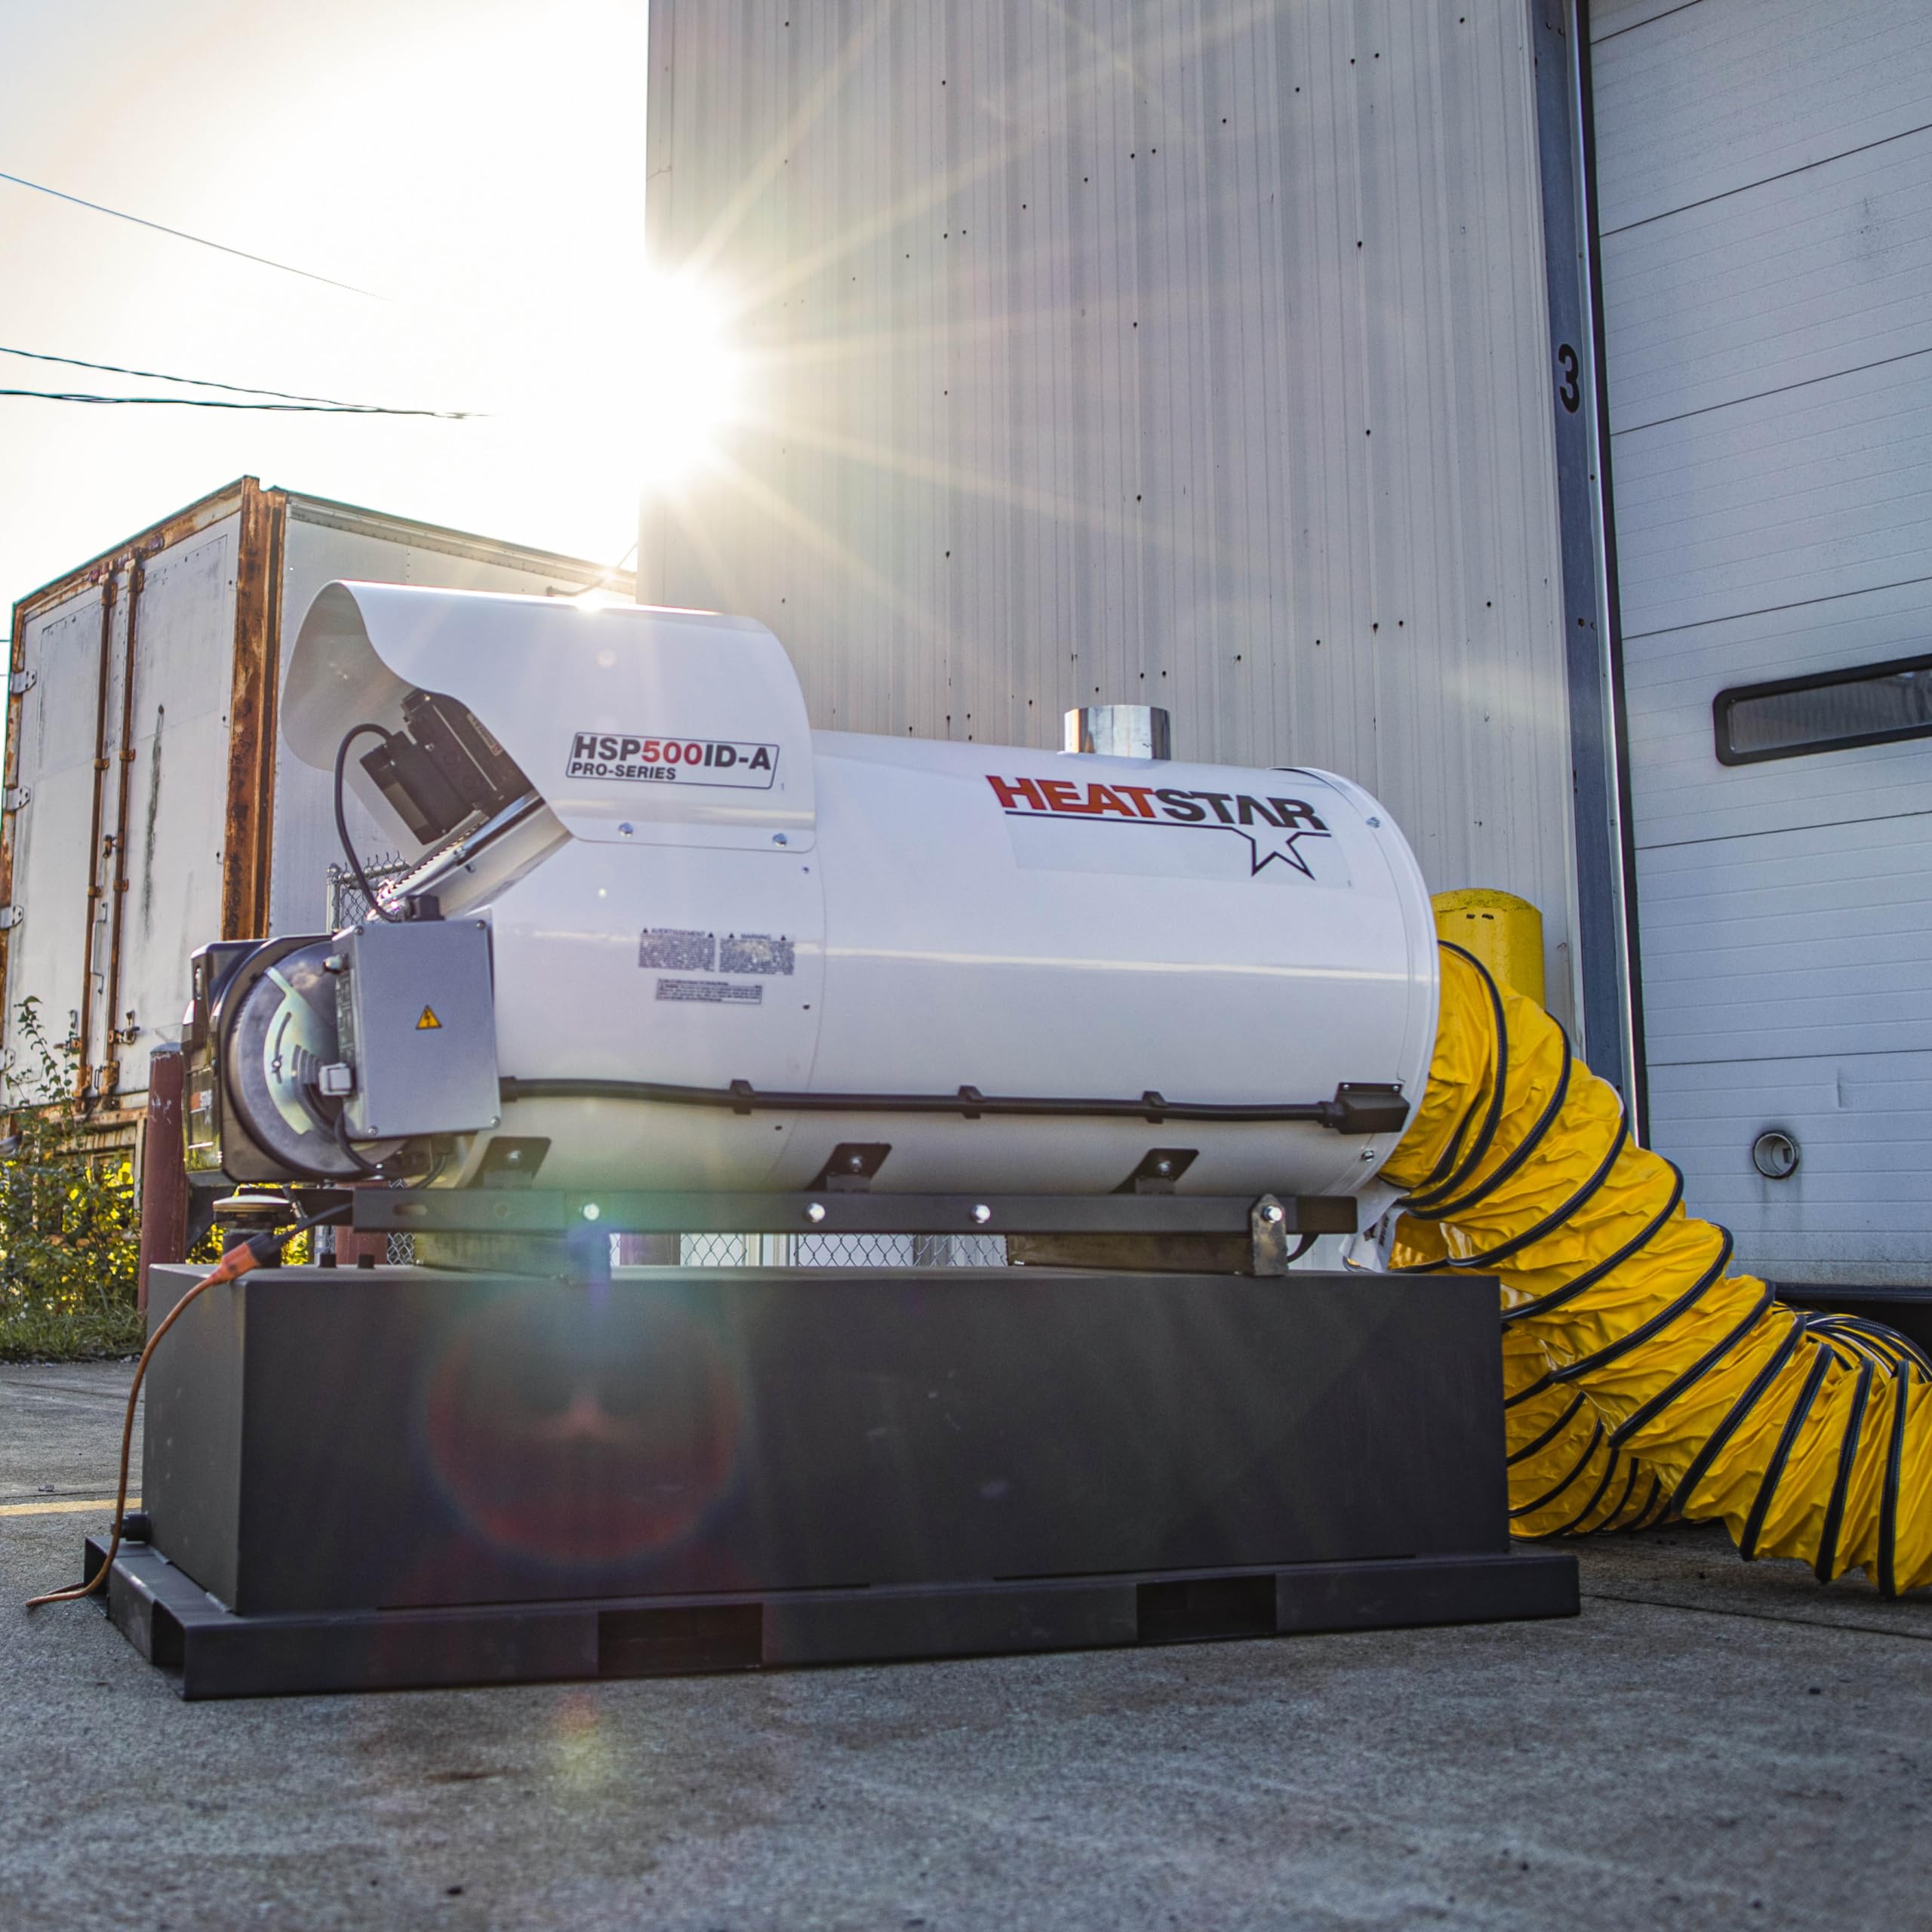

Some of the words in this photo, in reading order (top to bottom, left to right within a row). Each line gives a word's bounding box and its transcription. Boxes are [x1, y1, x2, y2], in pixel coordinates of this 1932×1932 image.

[1558, 343, 1580, 414] 3
[571, 762, 676, 780] PRO-SERIES
[574, 736, 771, 771] HSP500ID-A
[985, 774, 1330, 831] HEATSTAR
